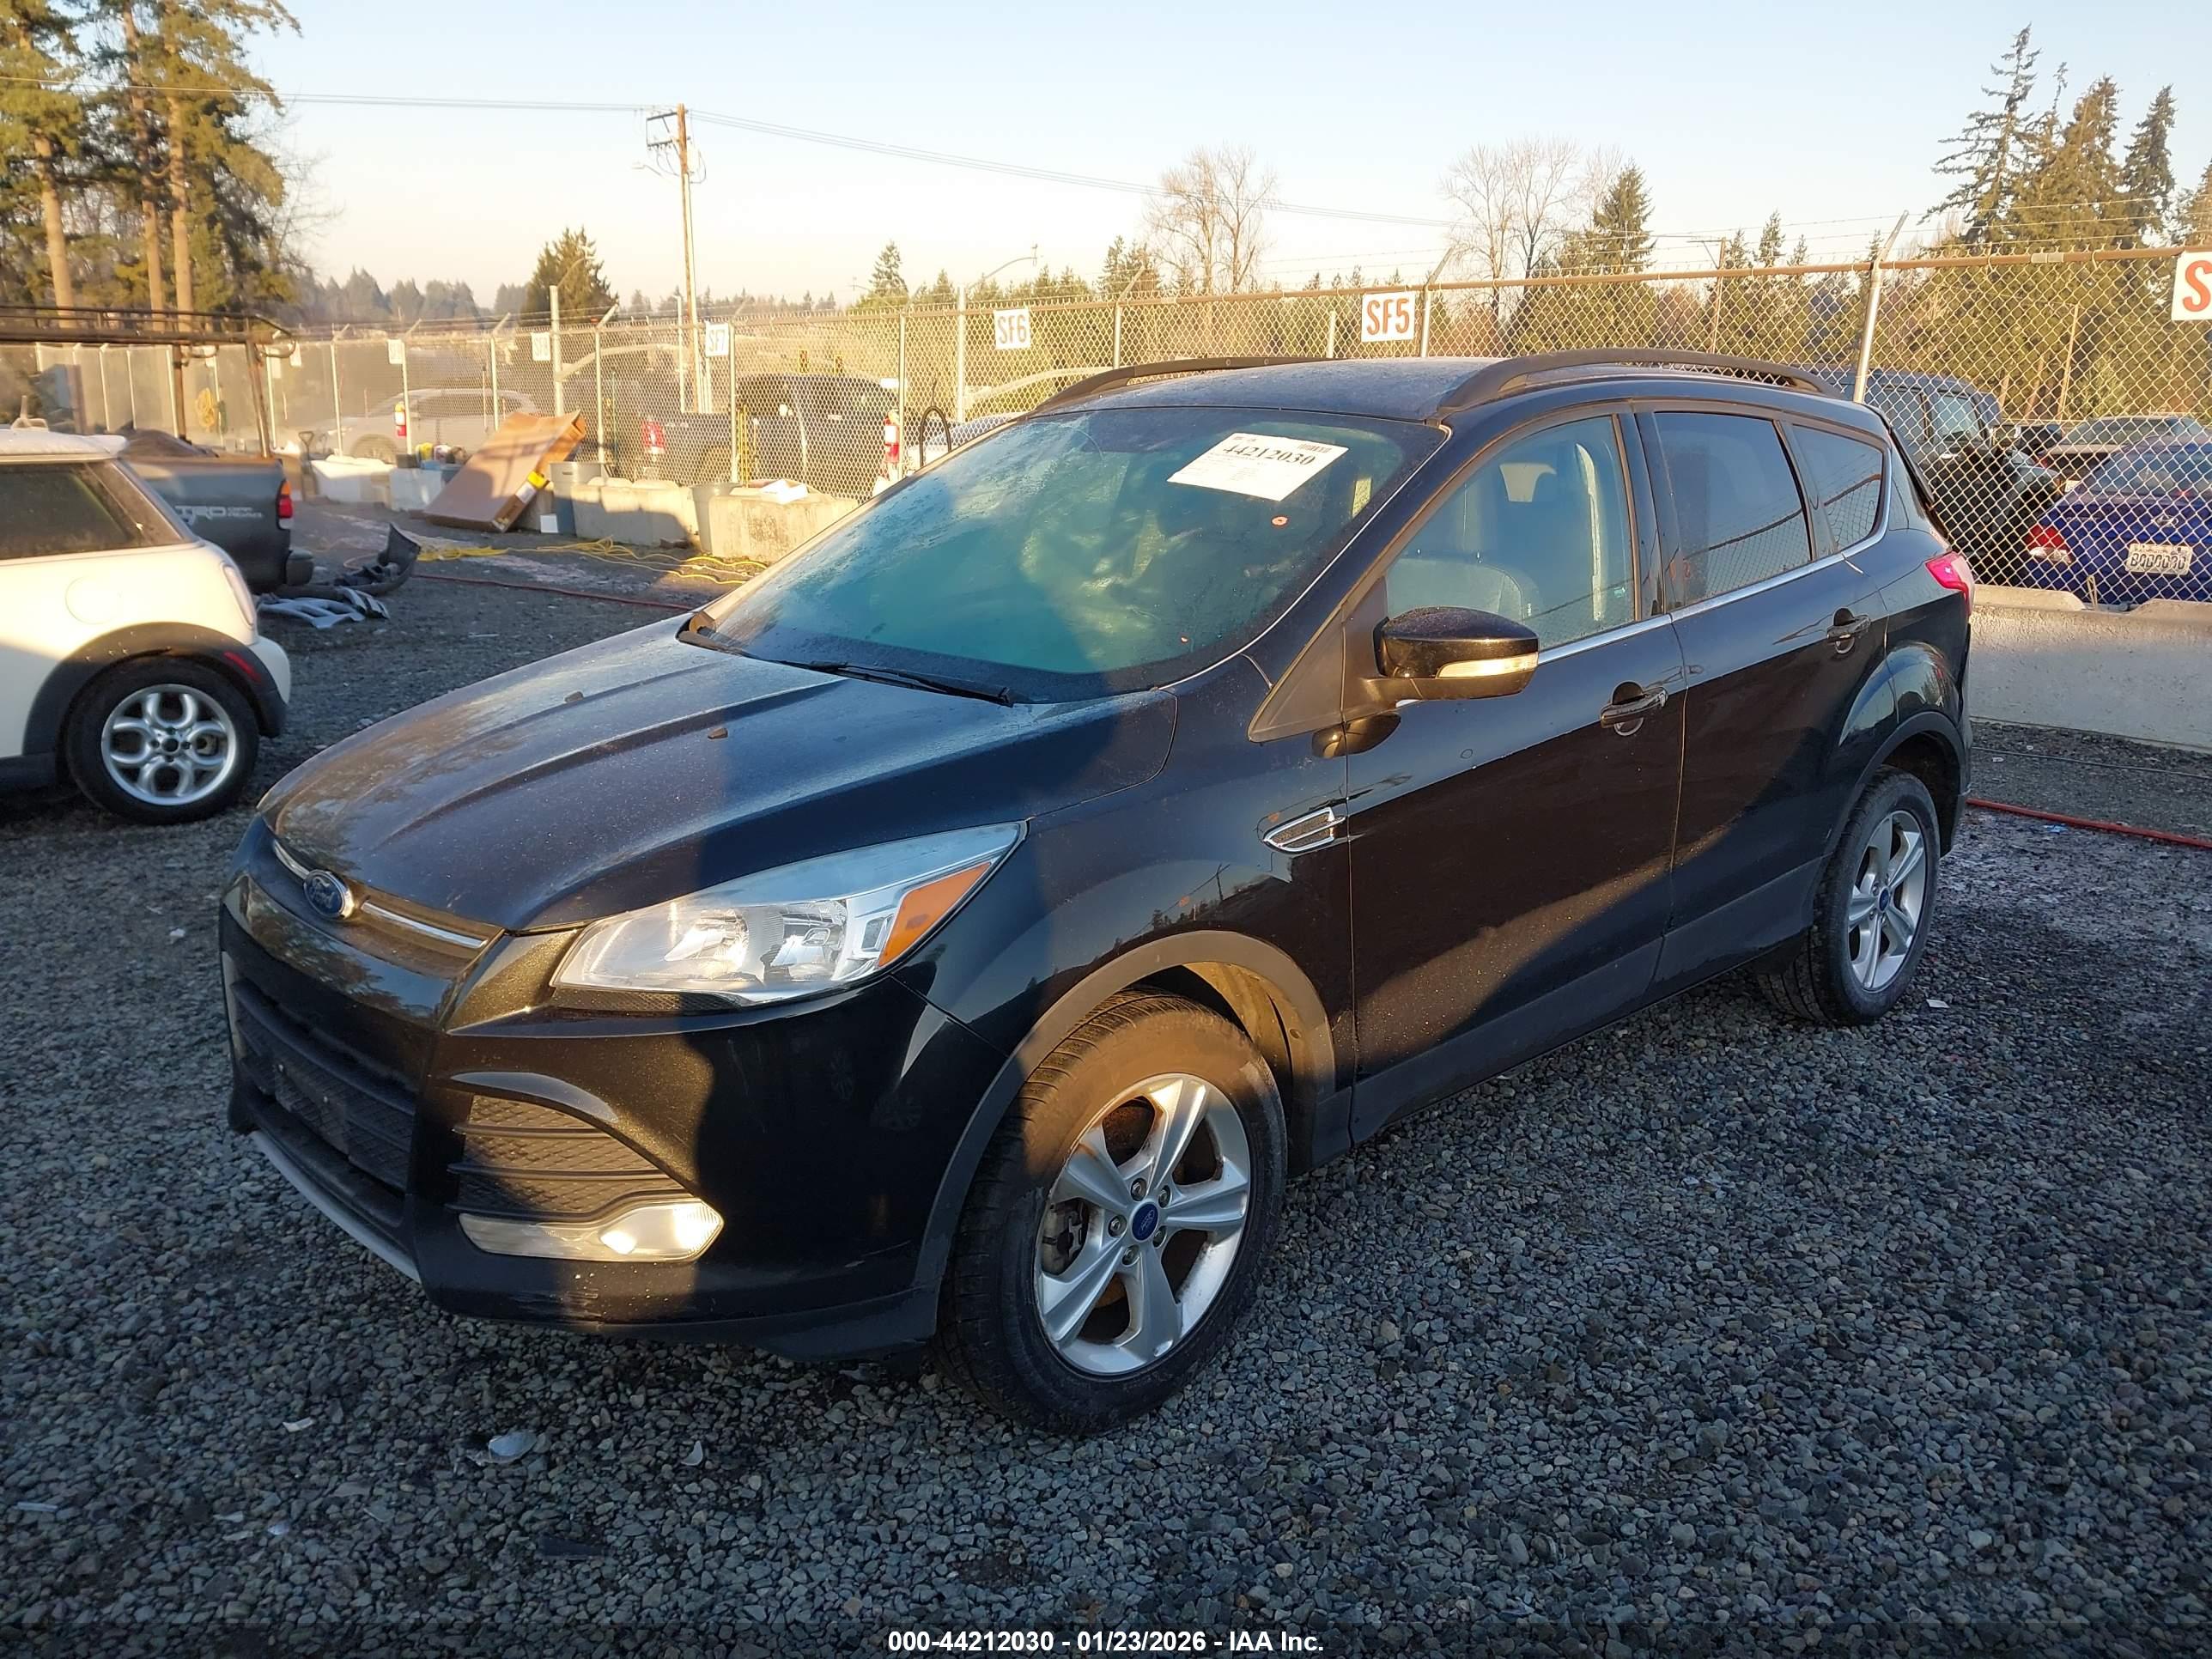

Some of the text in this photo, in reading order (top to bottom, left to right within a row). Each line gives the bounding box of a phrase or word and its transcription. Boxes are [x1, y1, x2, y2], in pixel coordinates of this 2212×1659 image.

[997, 314, 1027, 343] SF6
[1367, 298, 1410, 335] SF5
[708, 329, 726, 351] SF7
[1222, 443, 1316, 465] 44212030
